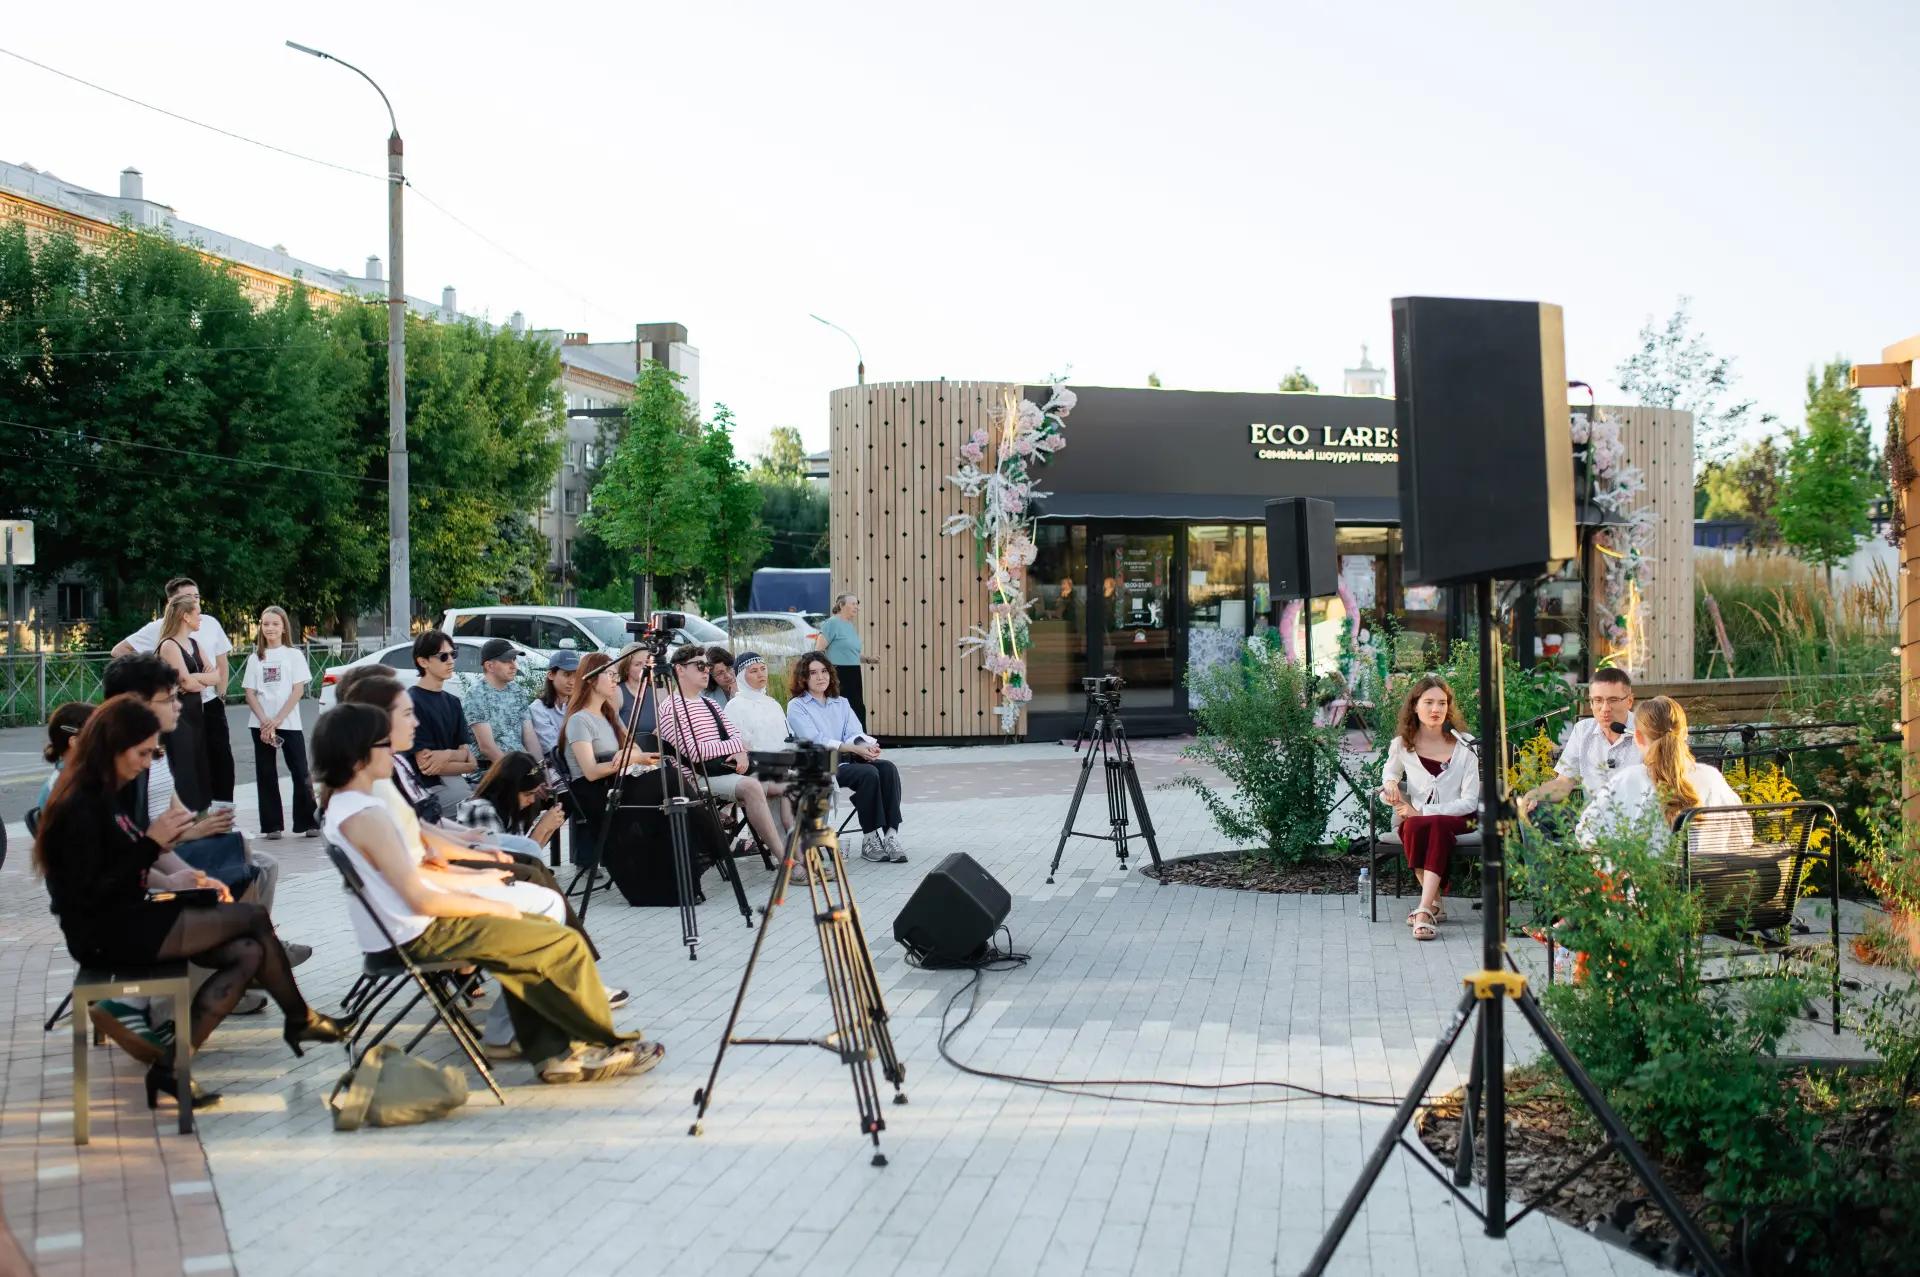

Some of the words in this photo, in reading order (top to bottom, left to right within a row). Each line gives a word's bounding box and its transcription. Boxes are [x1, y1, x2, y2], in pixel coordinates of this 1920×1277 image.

[1251, 423, 1309, 445] ECO
[1258, 448, 1315, 460] семейный
[1316, 451, 1361, 464] шоурум
